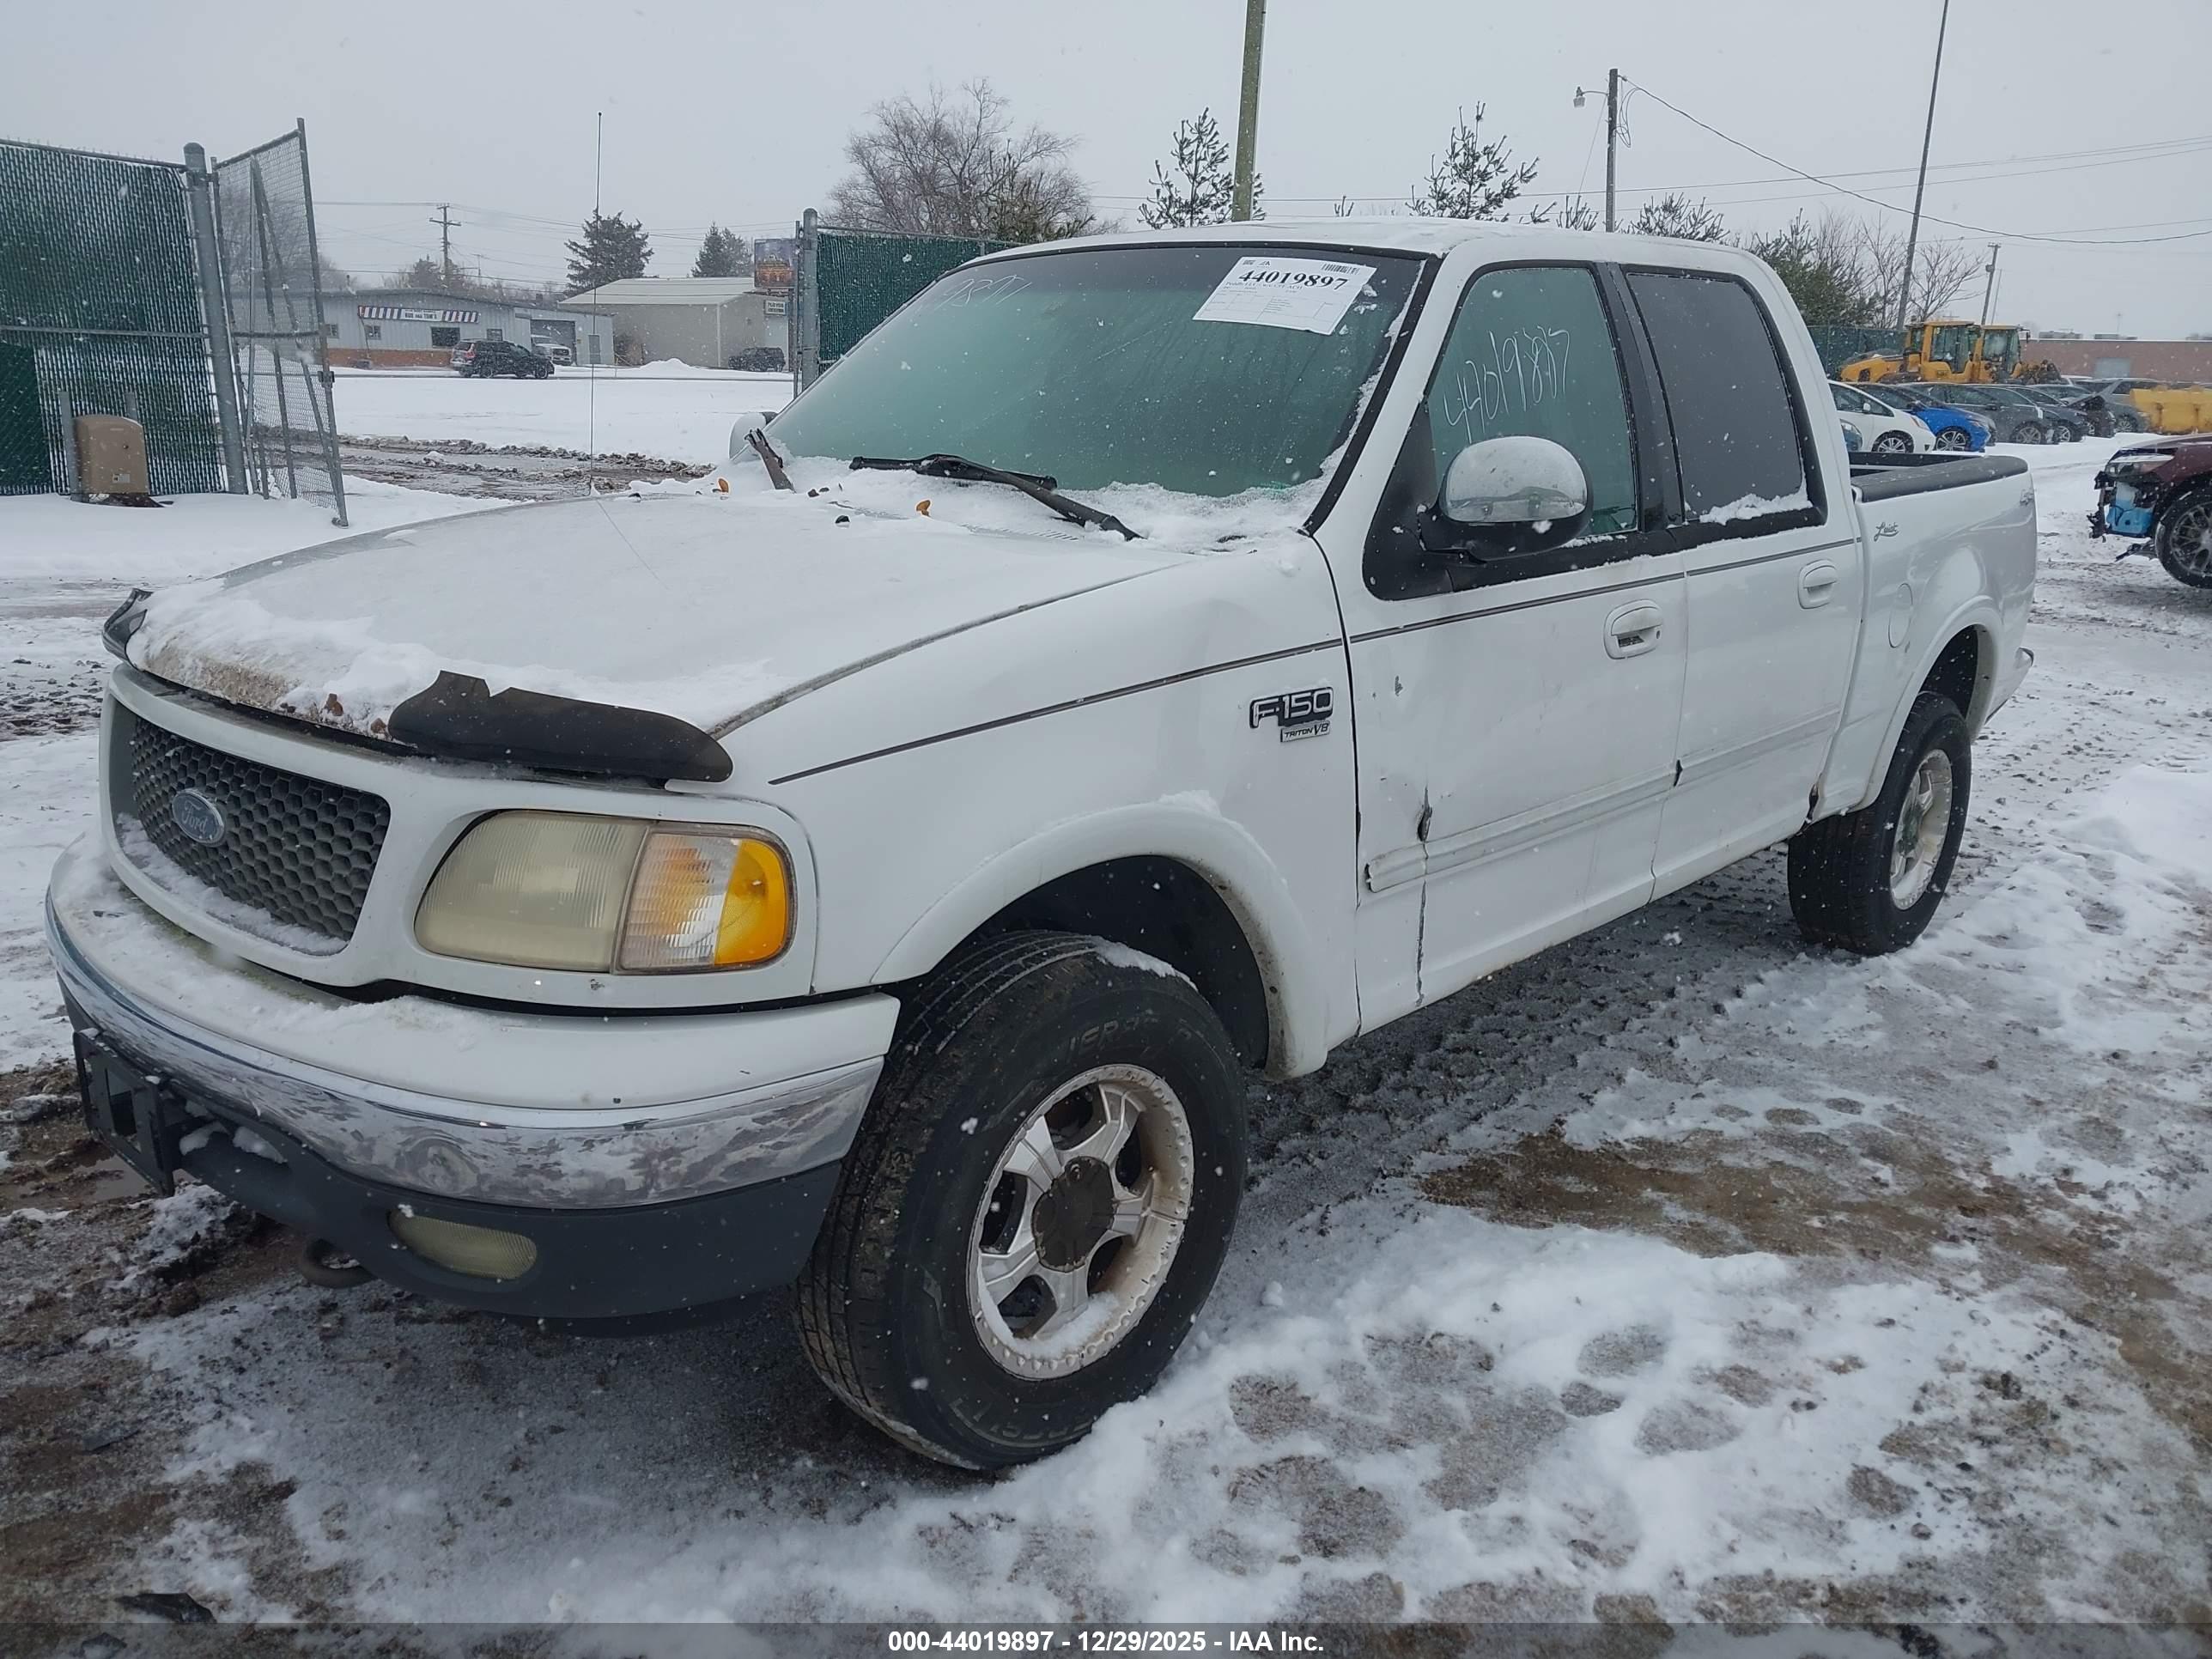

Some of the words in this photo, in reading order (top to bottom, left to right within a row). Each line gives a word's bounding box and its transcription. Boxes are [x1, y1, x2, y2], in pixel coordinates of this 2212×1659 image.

[1238, 269, 1350, 290] 44019897
[1284, 726, 1313, 738] TRITON
[1313, 722, 1330, 736] V8
